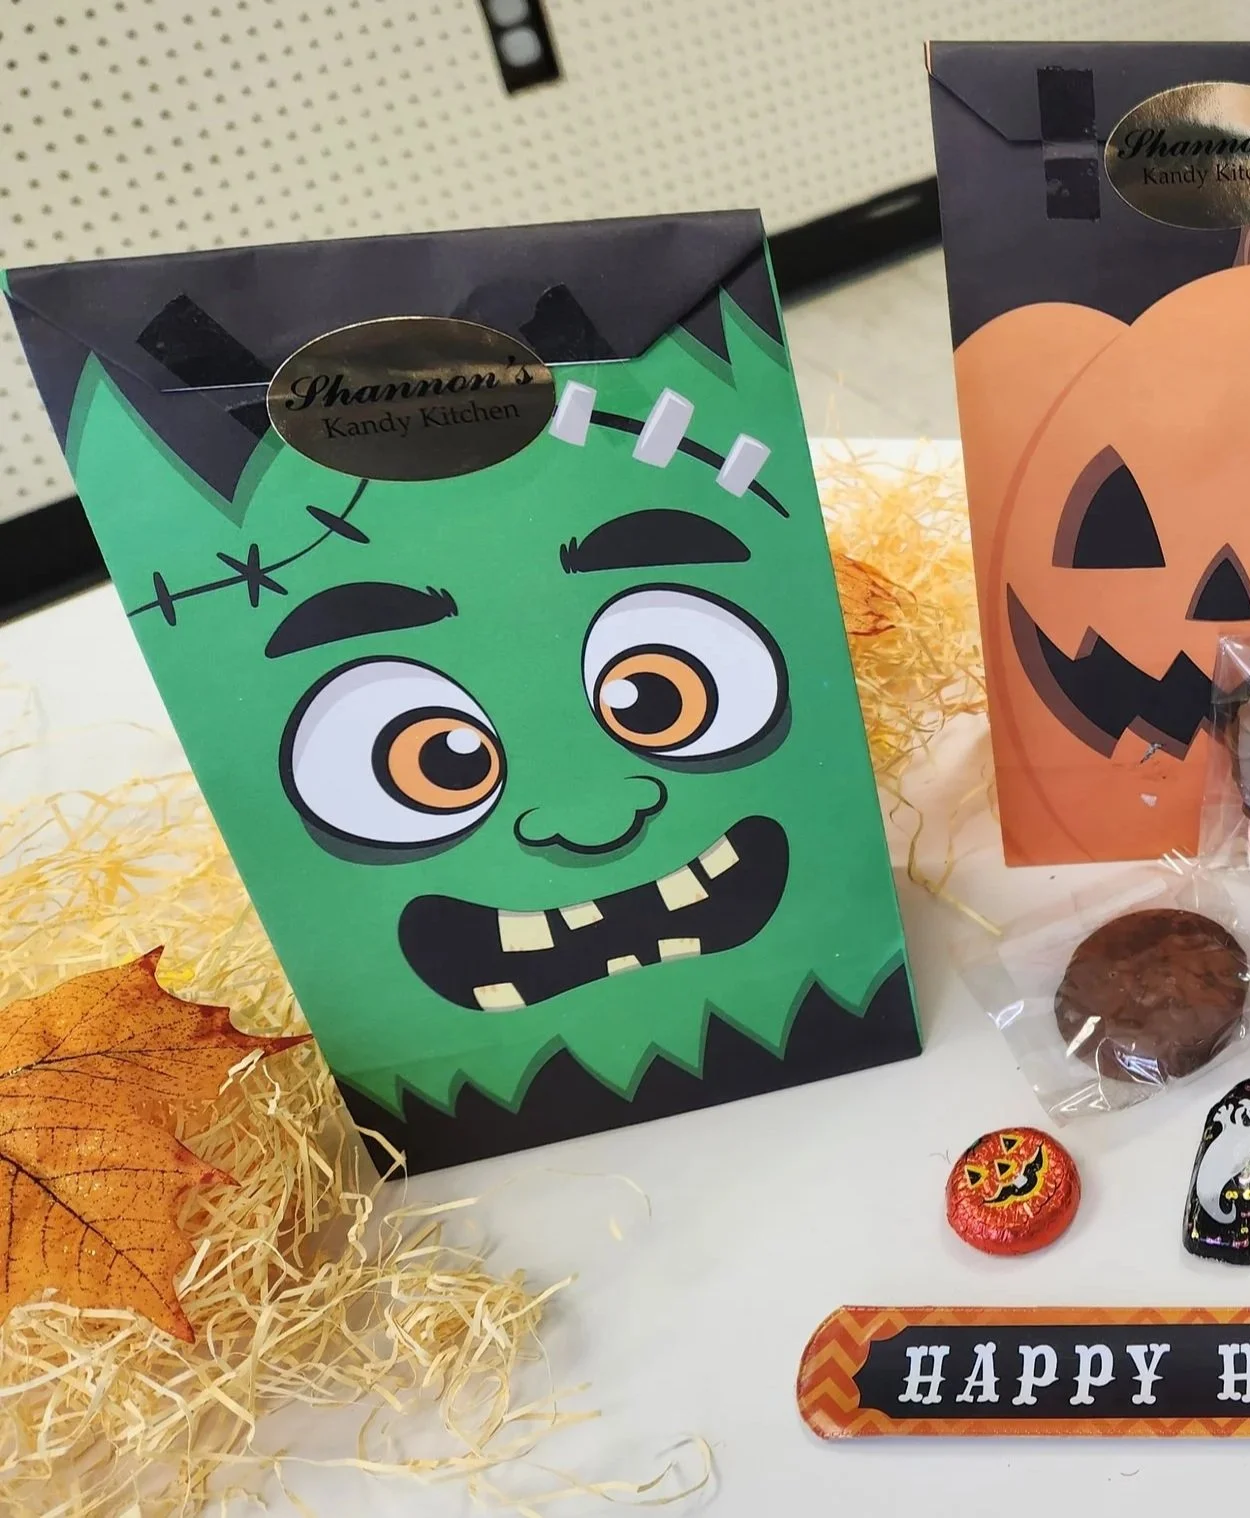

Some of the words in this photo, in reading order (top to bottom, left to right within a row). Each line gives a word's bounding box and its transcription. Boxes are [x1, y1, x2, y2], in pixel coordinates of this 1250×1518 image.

[1143, 164, 1209, 189] Kandy
[284, 354, 534, 412] Shannon's
[321, 411, 411, 439] Kandy
[419, 400, 521, 428] Kitchen
[898, 1341, 1171, 1406] HAPPY
